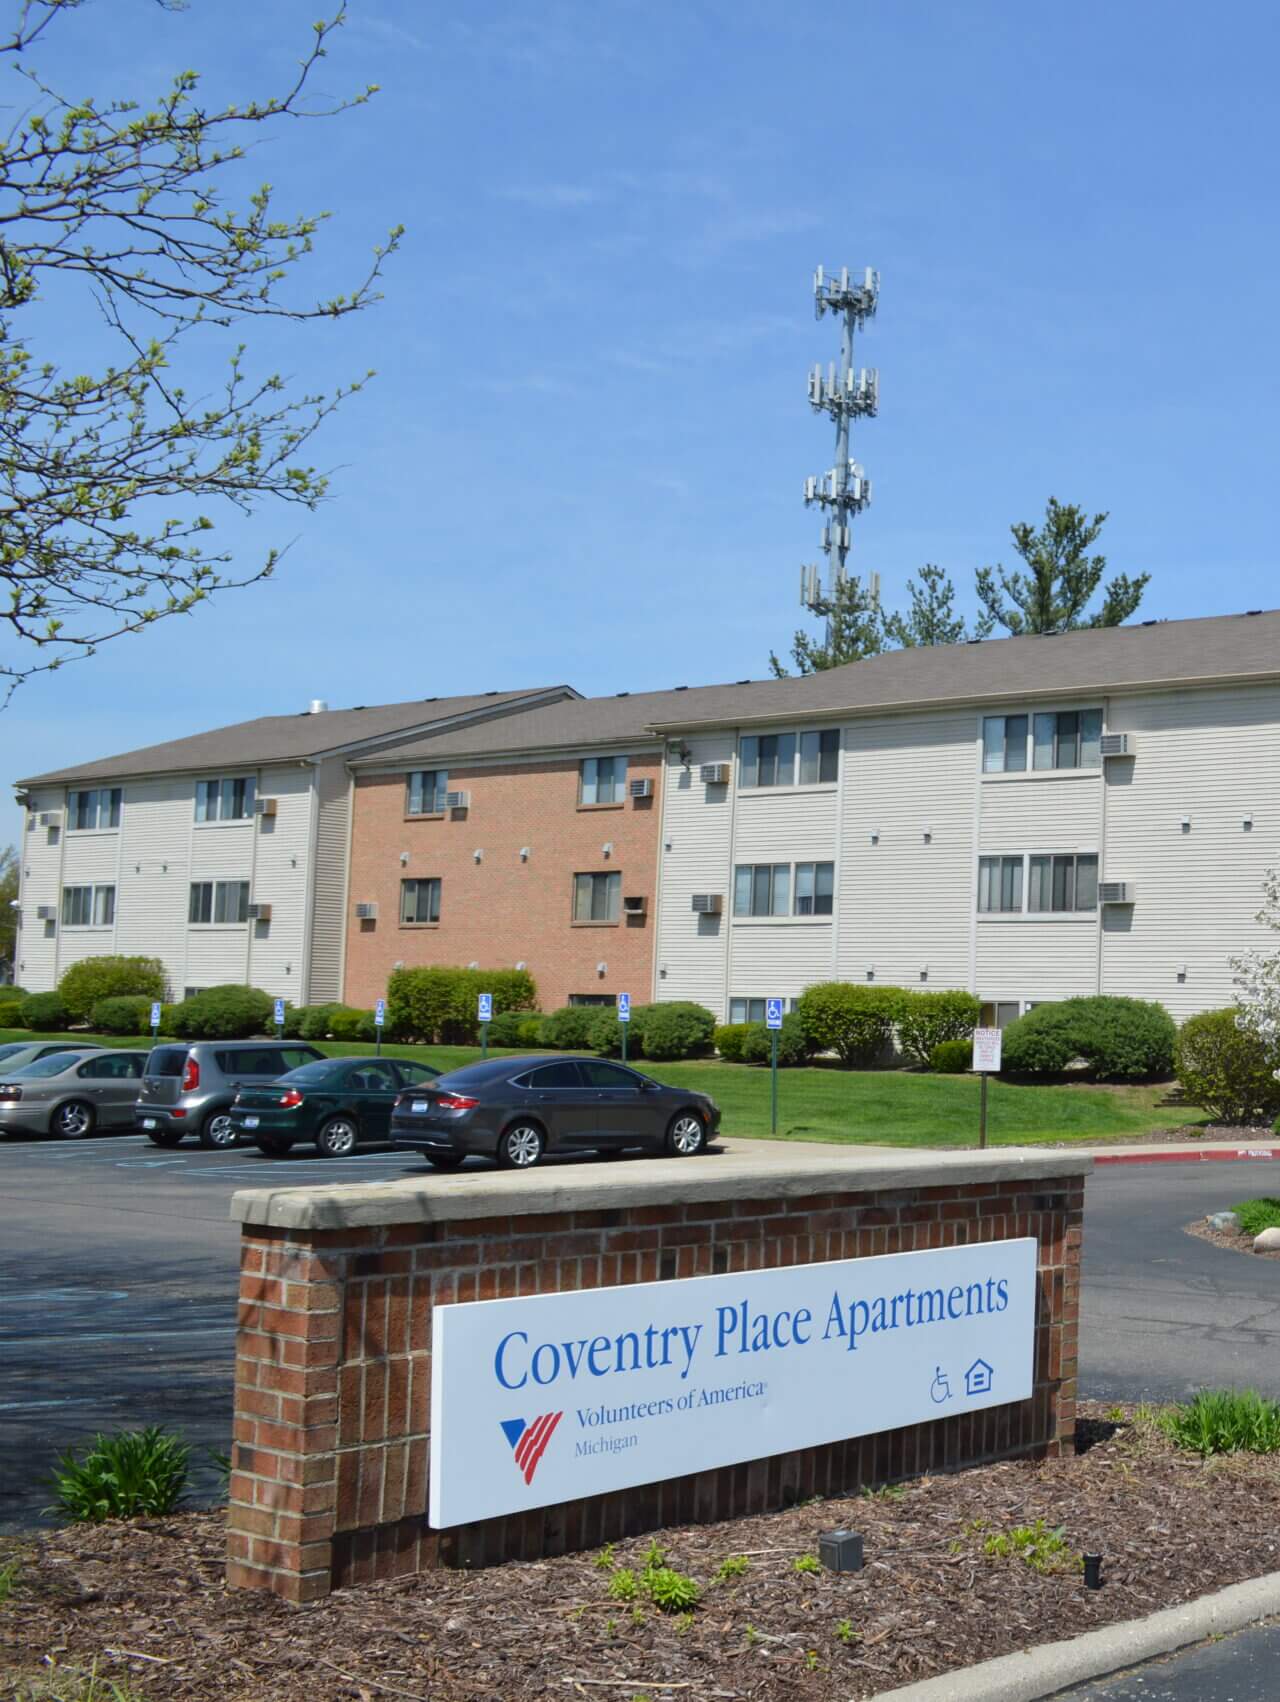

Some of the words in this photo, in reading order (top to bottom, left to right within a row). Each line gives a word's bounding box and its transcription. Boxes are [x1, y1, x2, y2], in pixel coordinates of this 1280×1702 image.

[494, 1323, 704, 1391] Coventry
[713, 1298, 812, 1358] Place
[821, 1276, 1009, 1352] Apartments
[576, 1399, 674, 1429] Volunteers
[676, 1388, 697, 1411] of
[697, 1381, 765, 1408] America
[575, 1433, 638, 1457] Michigan
